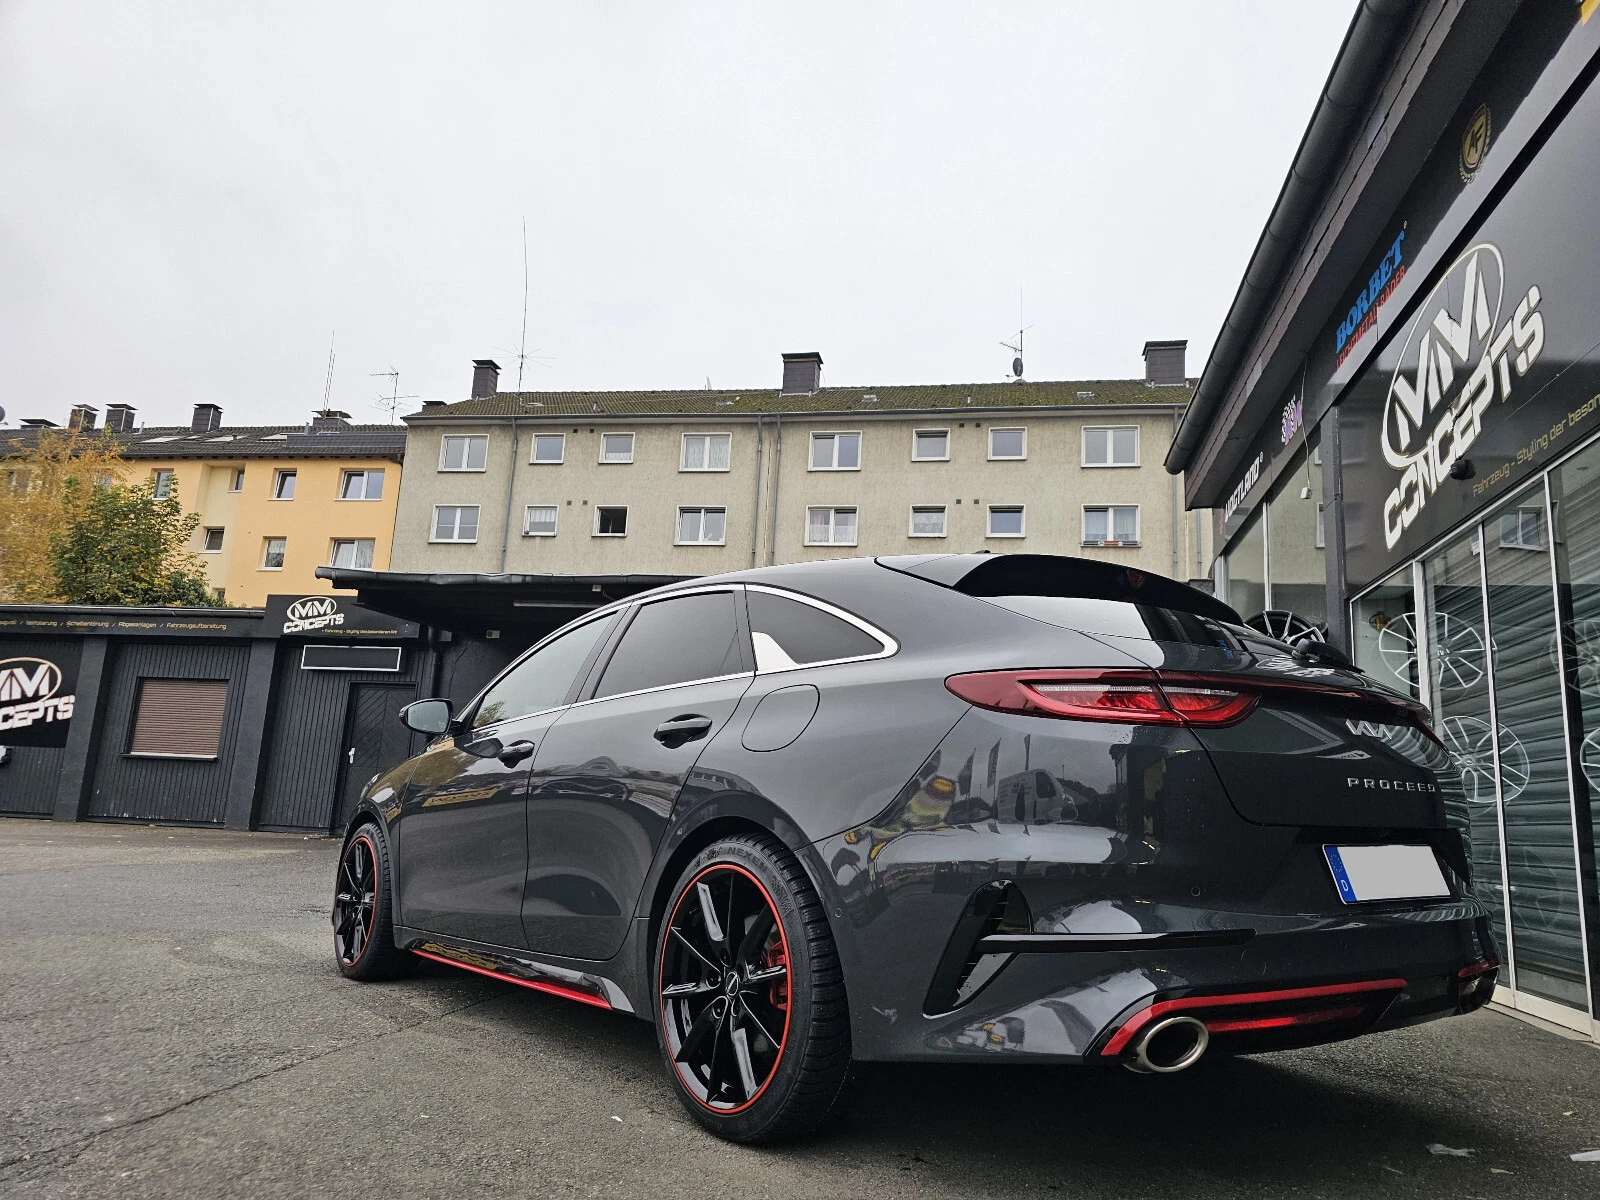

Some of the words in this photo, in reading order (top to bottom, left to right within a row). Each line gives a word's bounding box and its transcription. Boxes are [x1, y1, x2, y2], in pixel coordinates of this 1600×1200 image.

[1336, 230, 1405, 354] BORBET
[1384, 283, 1546, 552] CONCEPTS
[1473, 462, 1510, 498] Fahrzeug
[1516, 433, 1549, 465] Styling
[1549, 419, 1567, 441] der
[1224, 455, 1260, 523] VOGTLAND
[166, 622, 227, 631] Fahrzeugaufbereitung
[283, 612, 345, 634] CONCEPTS
[1347, 777, 1436, 793] PROCEED
[1340, 879, 1348, 892] D
